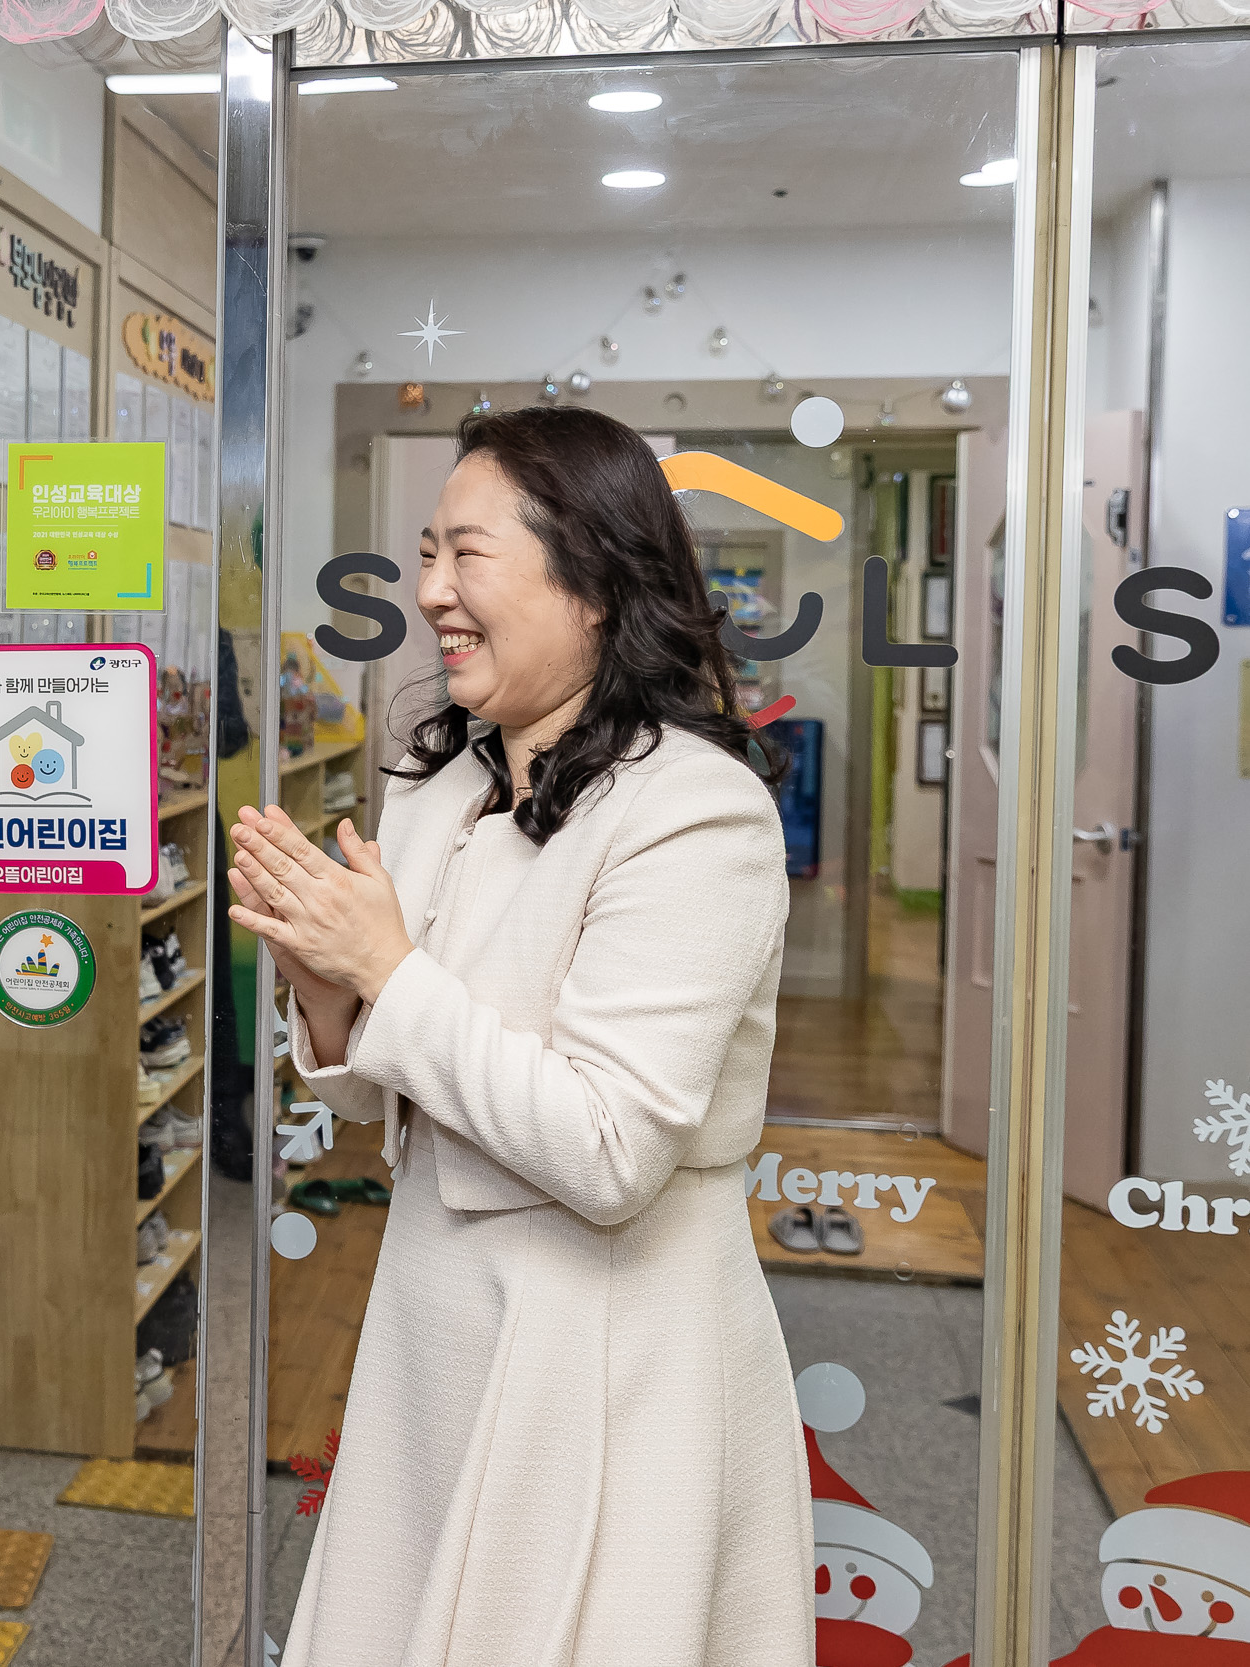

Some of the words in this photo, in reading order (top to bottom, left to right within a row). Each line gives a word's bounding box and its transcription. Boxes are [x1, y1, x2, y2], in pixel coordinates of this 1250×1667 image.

[32, 484, 142, 504] 인성교육대상
[32, 506, 75, 519] 우리아이
[76, 506, 140, 519] 행복프로젝트
[109, 658, 142, 669] 광진구
[5, 678, 34, 694] 함께
[37, 677, 109, 694] 만들어가는
[1, 915, 29, 935] 어린이집
[29, 914, 65, 929] 안전공제회
[5, 977, 33, 987] 어린이집
[34, 979, 70, 989] 안전공제회
[4, 1001, 46, 1022] 안전사고예방
[745, 1152, 938, 1223] Merry
